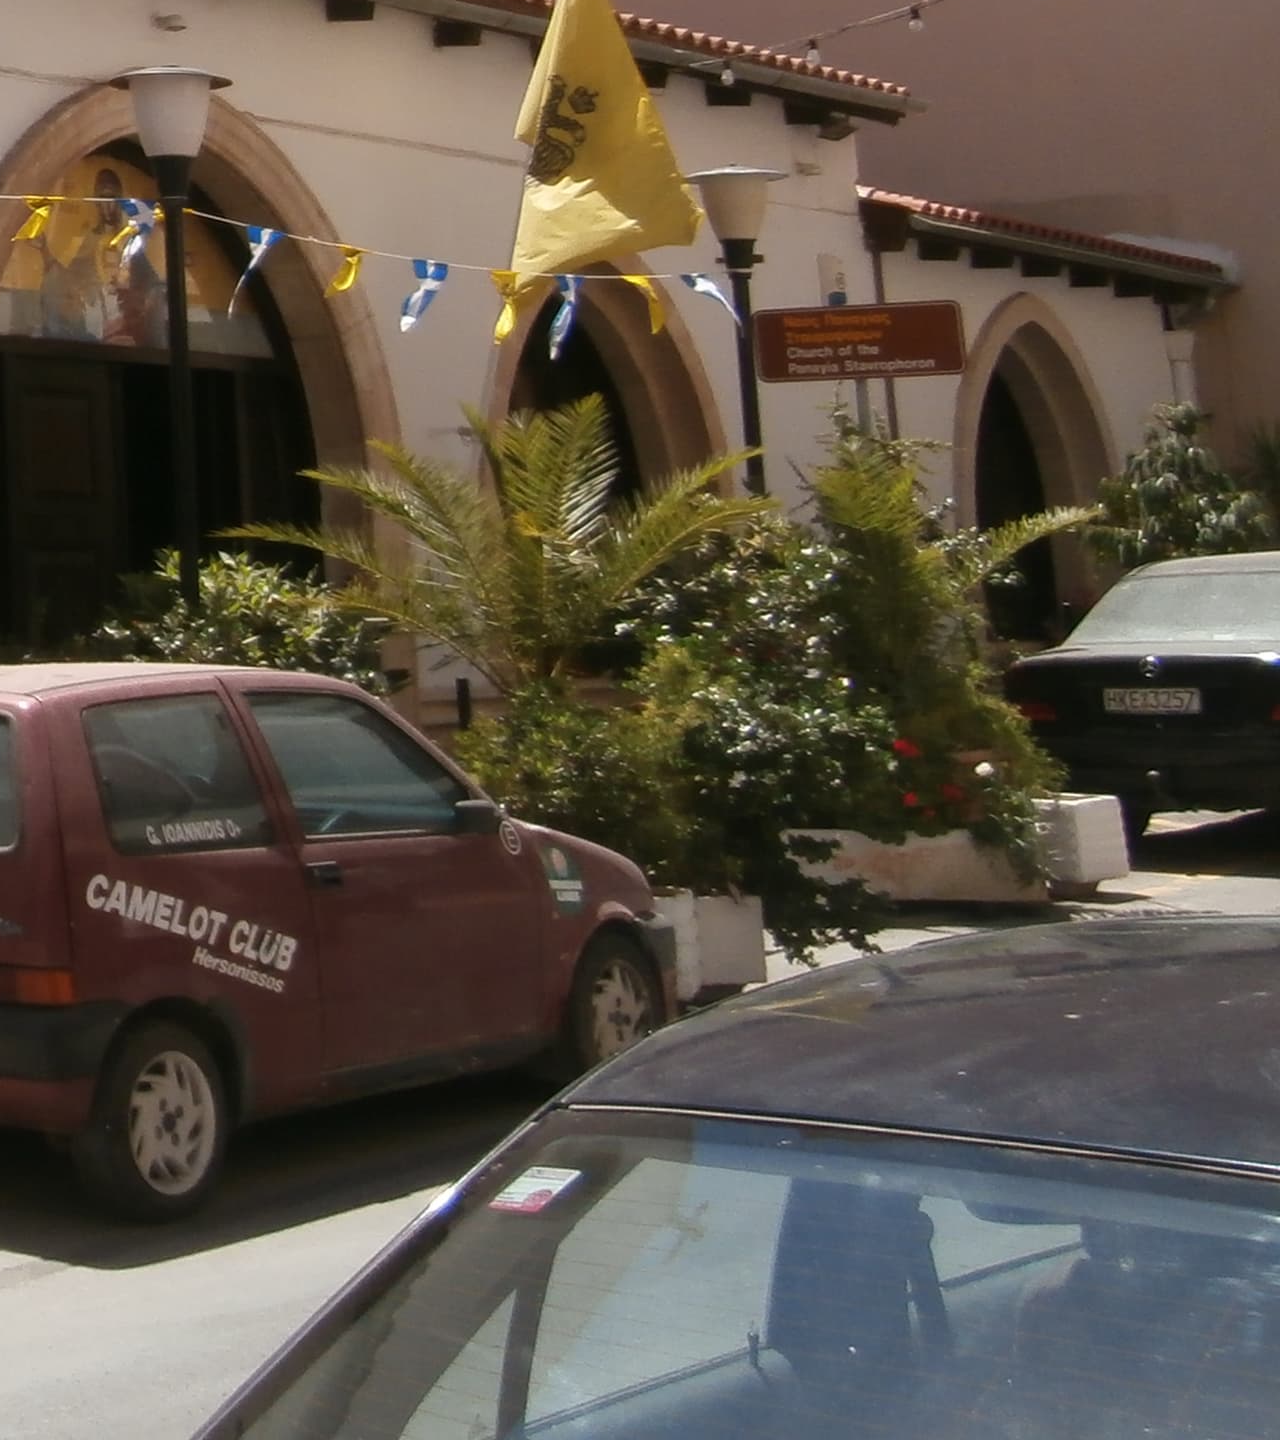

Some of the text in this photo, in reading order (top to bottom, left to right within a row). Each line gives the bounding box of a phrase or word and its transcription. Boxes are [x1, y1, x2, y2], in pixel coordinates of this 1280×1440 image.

[787, 344, 880, 359] Church of the
[162, 819, 226, 843] IOANNIDIS
[86, 874, 228, 946] CAMELOT
[229, 920, 297, 971] CLUB
[193, 946, 286, 993] Hersonissos
